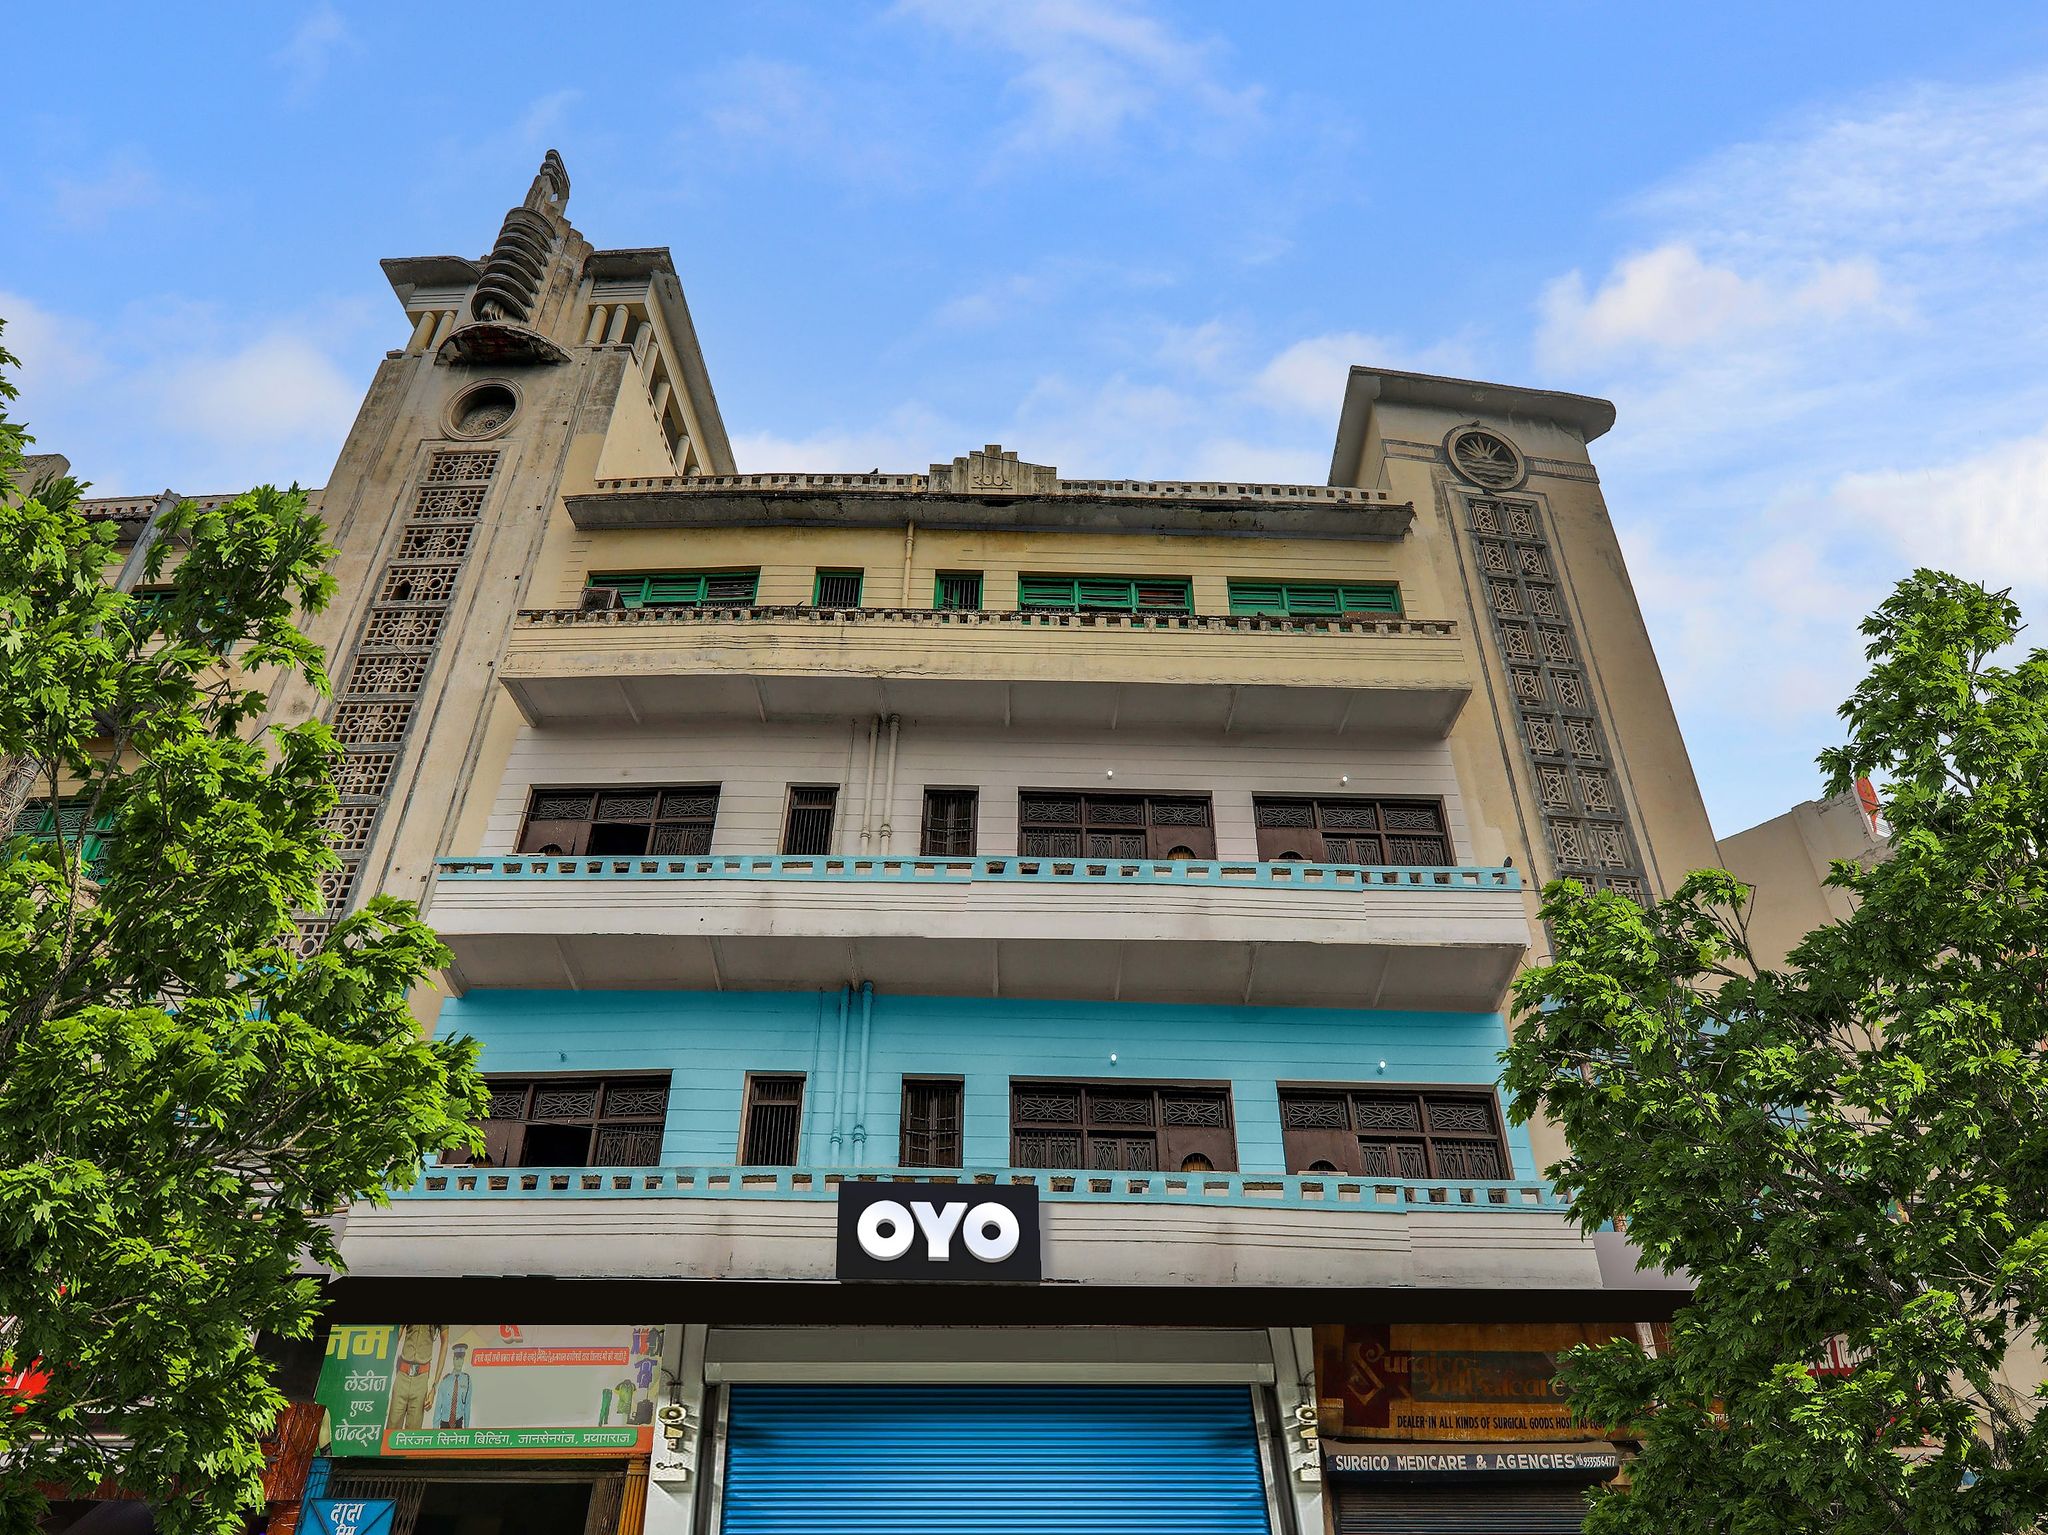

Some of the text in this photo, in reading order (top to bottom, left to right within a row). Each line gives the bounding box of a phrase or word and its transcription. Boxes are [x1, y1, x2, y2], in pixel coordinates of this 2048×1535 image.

[857, 1200, 1020, 1263] OYO
[344, 1370, 388, 1391] लेडीज
[350, 1400, 374, 1417] एण्ड
[1439, 1417, 1454, 1428] ALL
[1456, 1417, 1479, 1429] KINDS
[1481, 1417, 1491, 1429] OF
[1493, 1417, 1528, 1429] SURGICAL
[1530, 1417, 1554, 1429] GOODS
[1556, 1417, 1589, 1430] HOSTAL
[396, 1430, 631, 1446] निरंजन सिनेमा बिल्डिंग, जानसेनगंज, प्रयागराज
[1335, 1455, 1390, 1471] SURGICO
[1397, 1455, 1467, 1471] MEDICARE
[1476, 1454, 1487, 1470] &
[1496, 1454, 1575, 1469] AGENCIES
[330, 1503, 366, 1524] दादा
